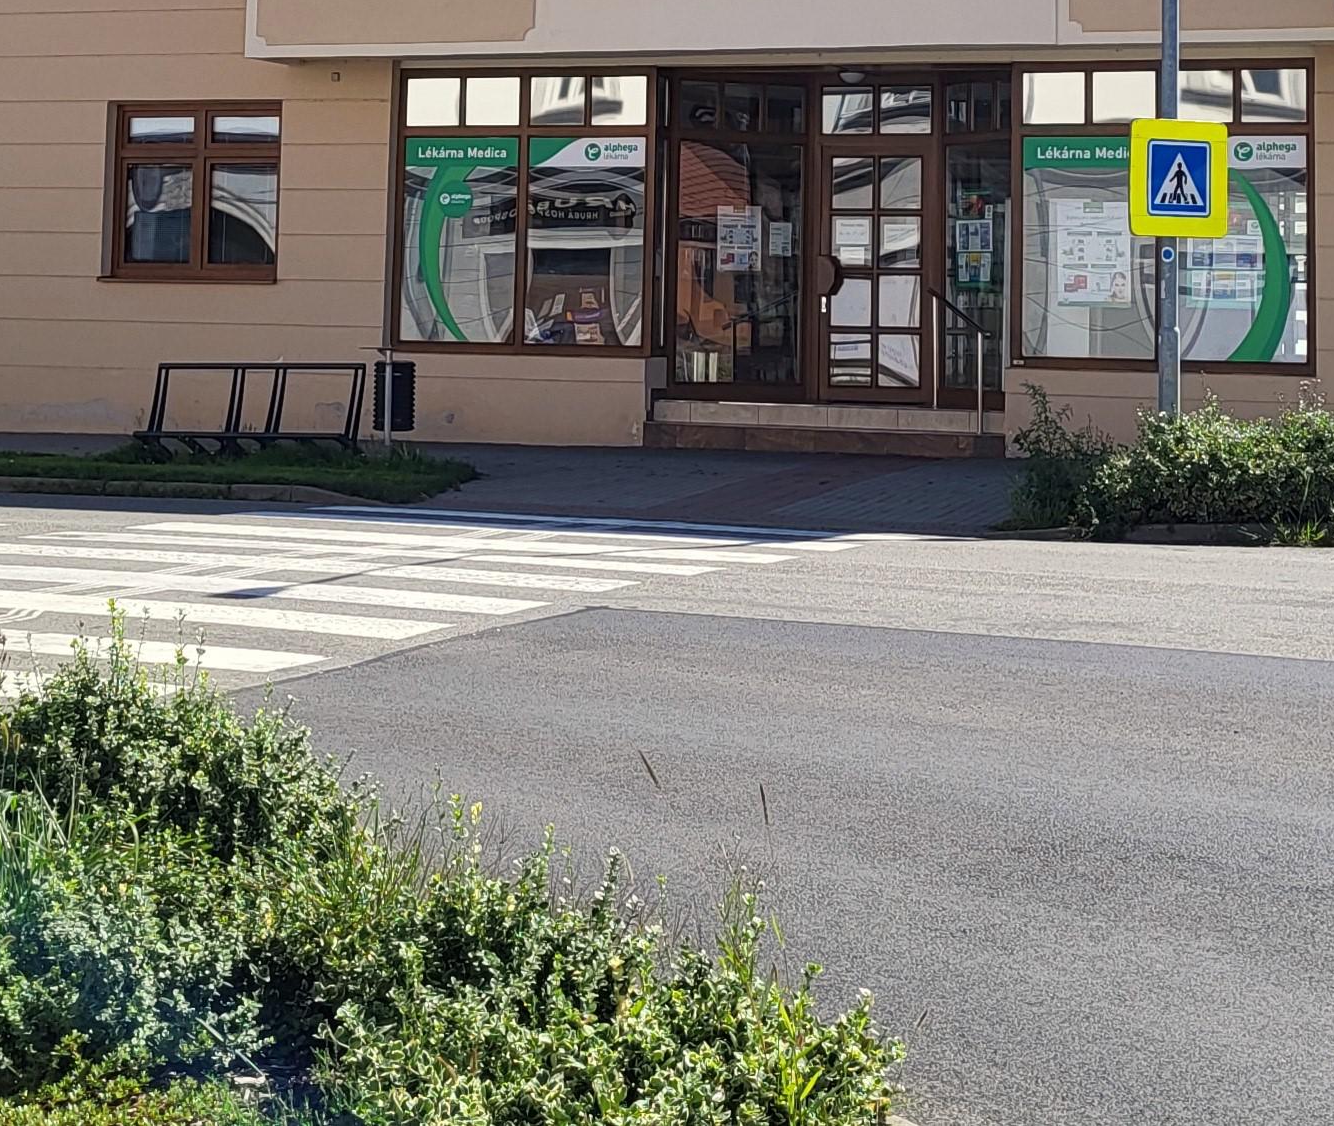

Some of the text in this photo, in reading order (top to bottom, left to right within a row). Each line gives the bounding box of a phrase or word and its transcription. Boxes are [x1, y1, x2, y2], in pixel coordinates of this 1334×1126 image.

[418, 146, 507, 158] Lékárna Medica
[603, 143, 638, 153] alphega
[1037, 146, 1130, 159] Lékárna Medi
[1256, 142, 1297, 153] alphega
[603, 152, 629, 160] lékárna
[1256, 152, 1286, 160] lékárna
